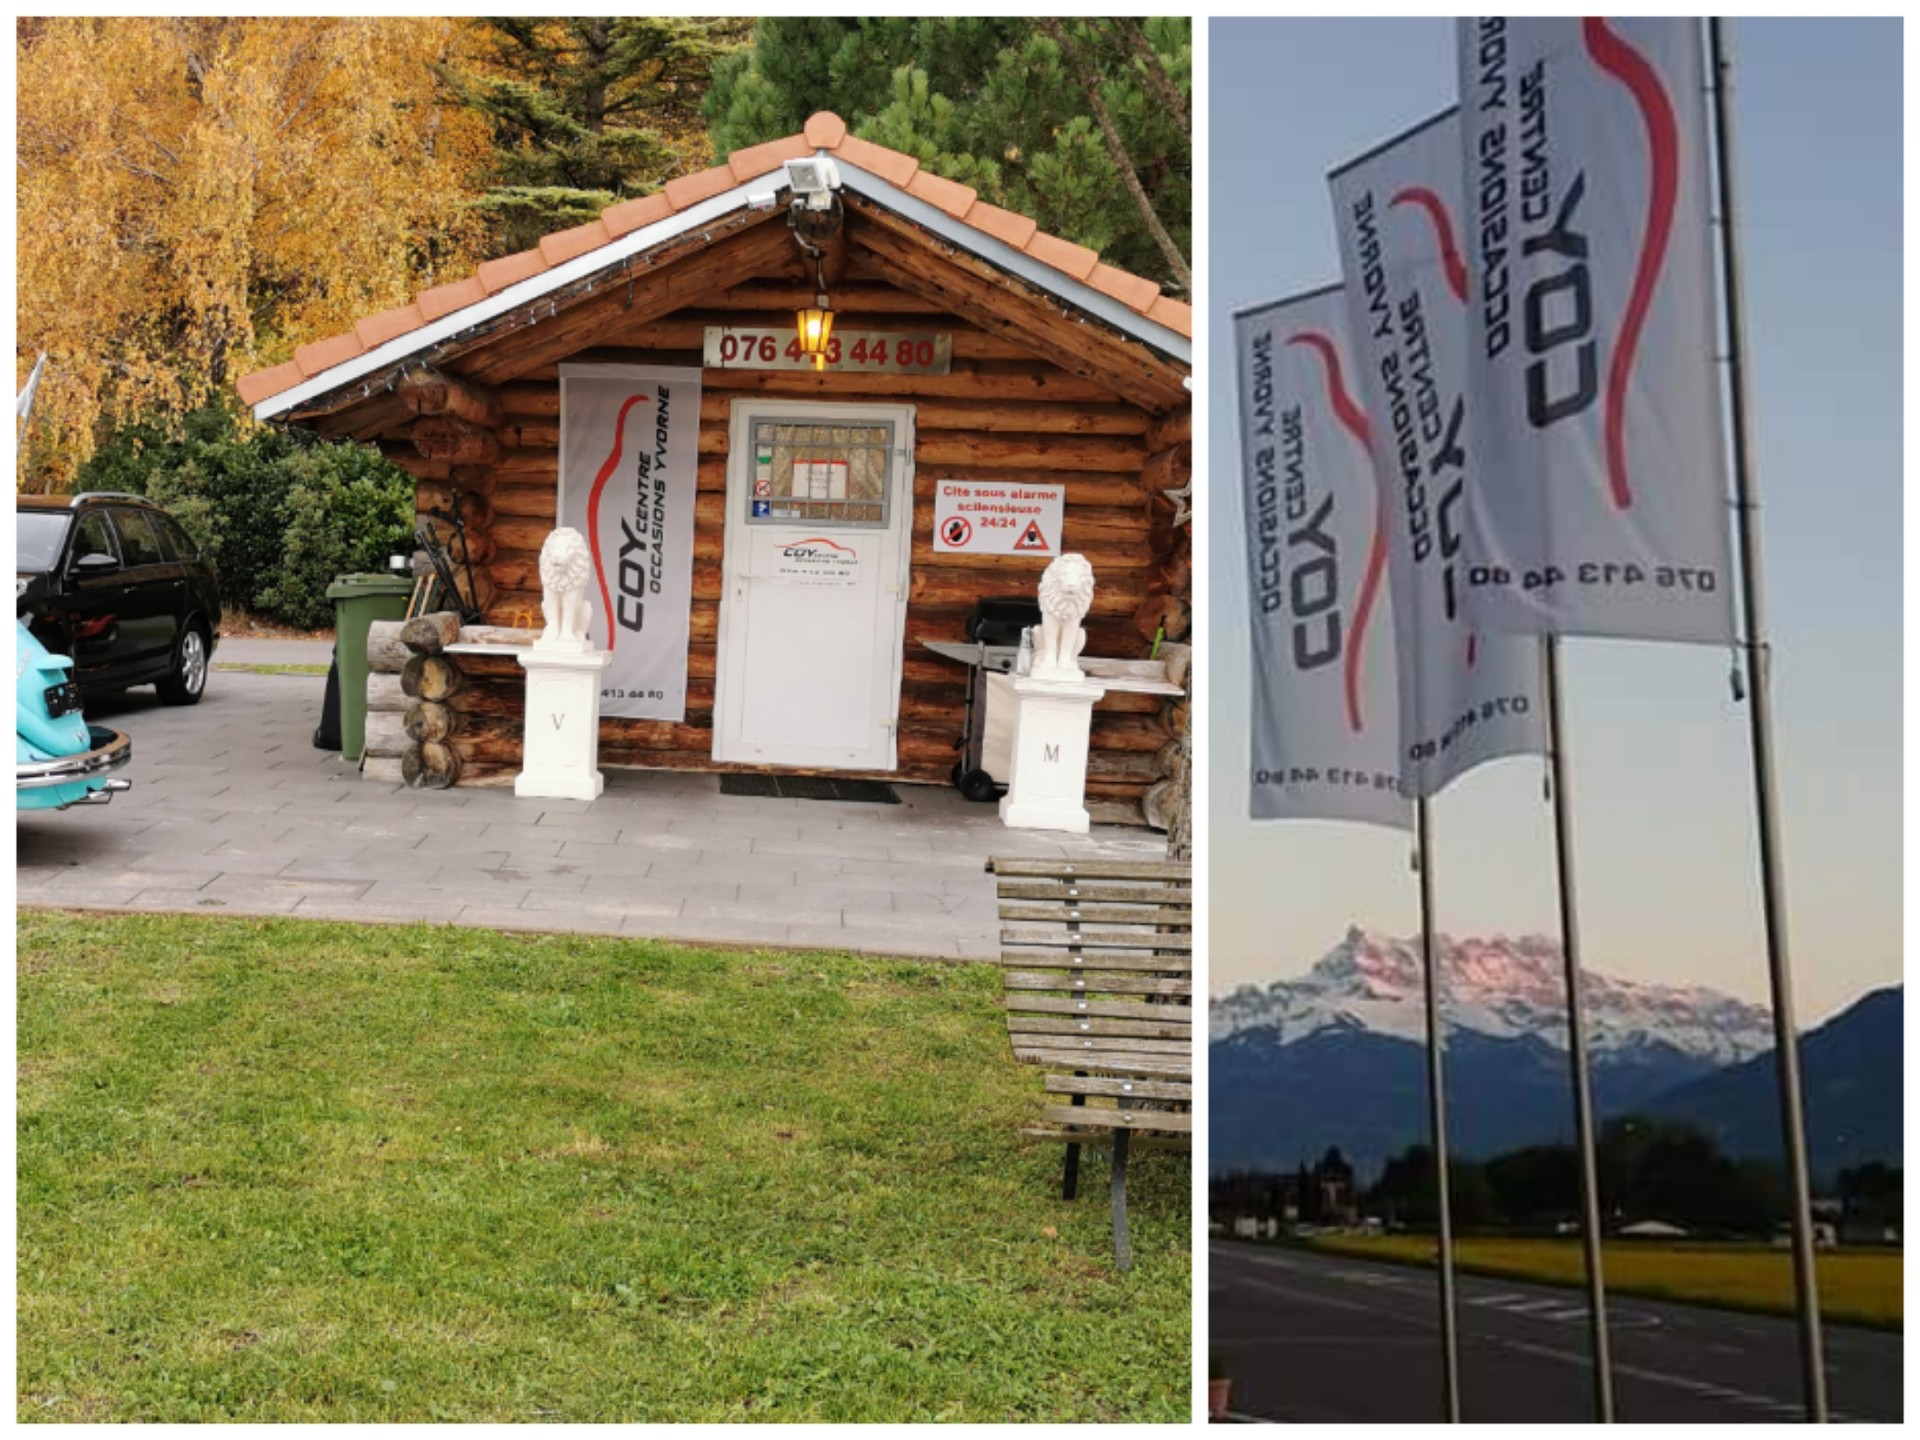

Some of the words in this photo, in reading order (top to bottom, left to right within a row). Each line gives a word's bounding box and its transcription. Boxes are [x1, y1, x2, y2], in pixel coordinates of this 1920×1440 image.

[720, 334, 777, 362] 076
[785, 337, 842, 364] 43
[850, 338, 889, 365] 44
[895, 340, 935, 367] 80
[654, 385, 670, 471] YVORNE
[974, 488, 1006, 497] sous
[1010, 488, 1058, 499] alarme
[617, 515, 647, 632] COY
[636, 451, 651, 534] CENTRE
[650, 479, 666, 594] OCCASIONS
[783, 547, 818, 557] COY
[551, 713, 565, 731] V
[1043, 743, 1060, 763] M
